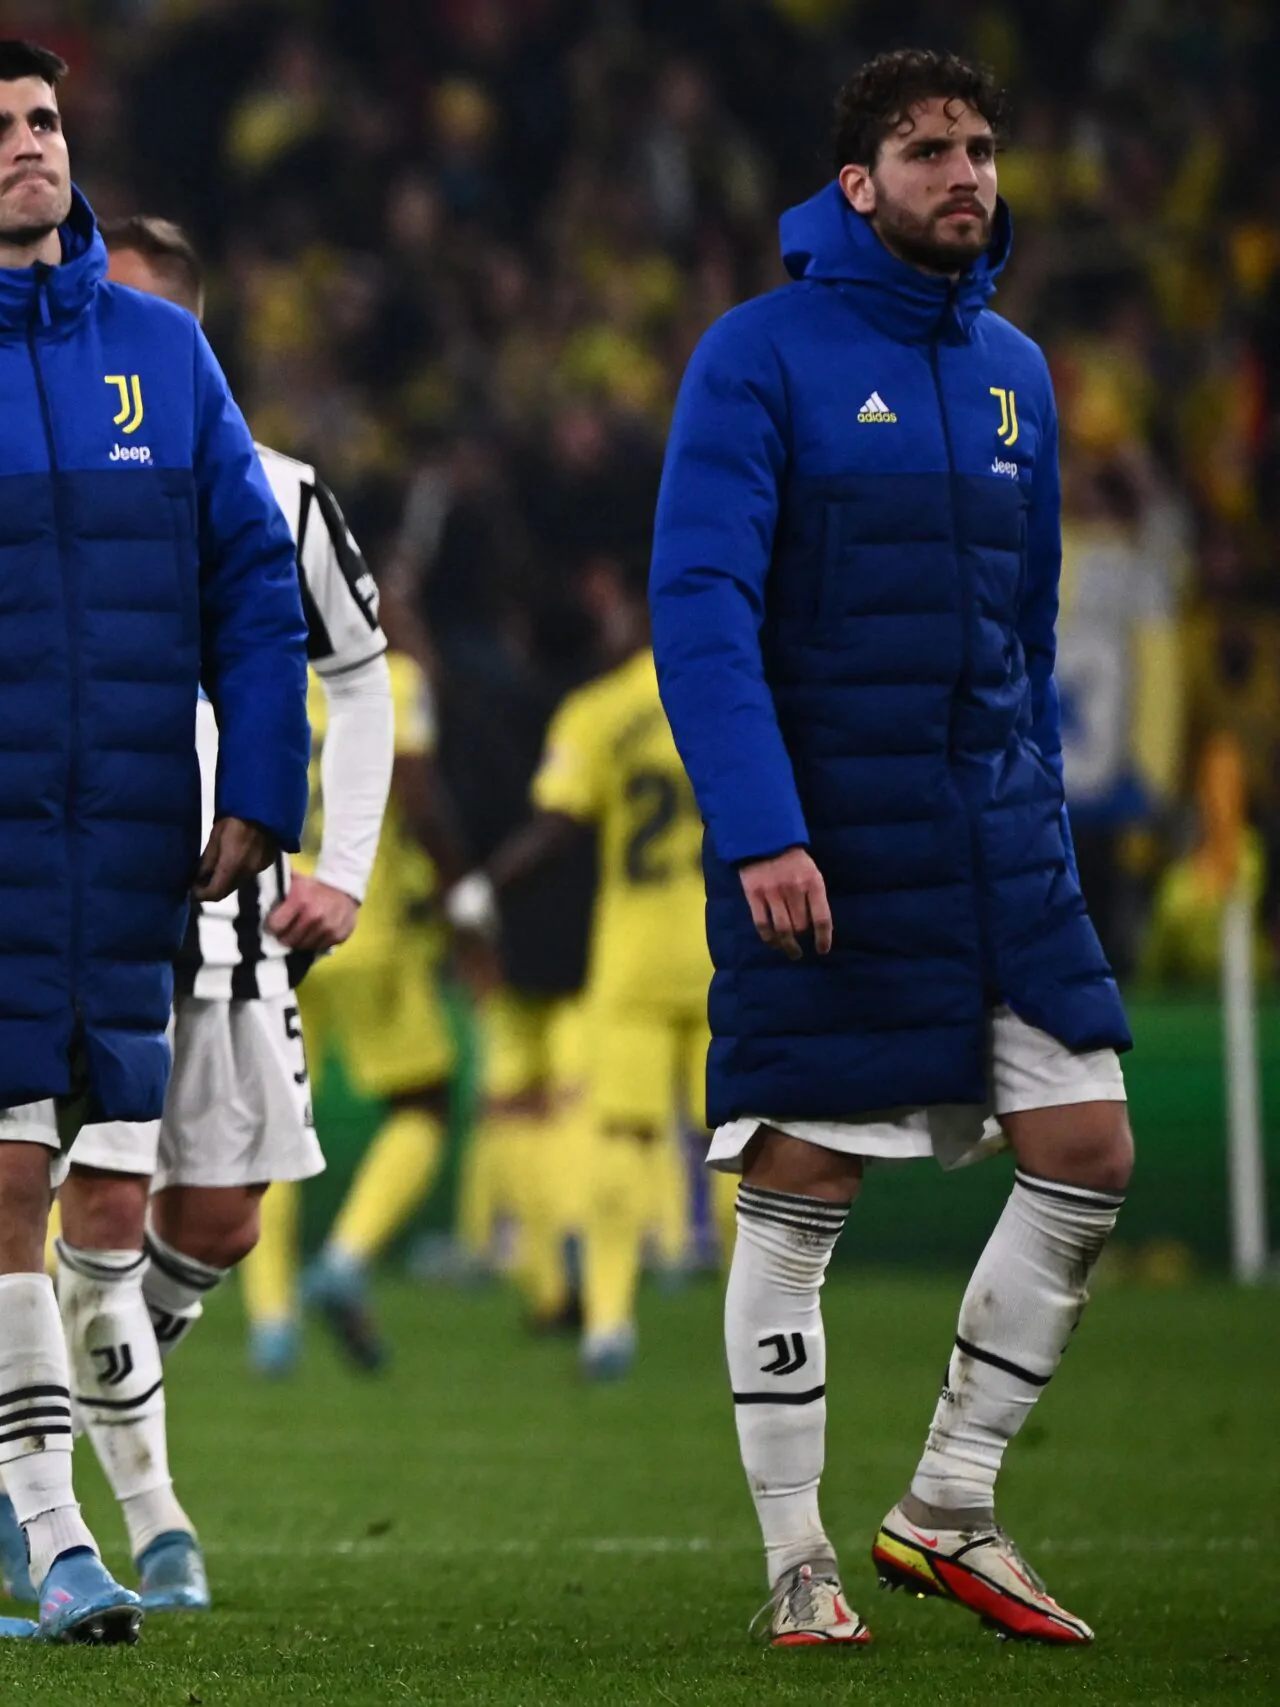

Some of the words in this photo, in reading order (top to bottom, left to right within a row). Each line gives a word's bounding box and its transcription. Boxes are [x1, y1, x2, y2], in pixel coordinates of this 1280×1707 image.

[857, 410, 898, 423] adidas
[109, 443, 151, 464] Jeep
[991, 456, 1018, 480] Jeep
